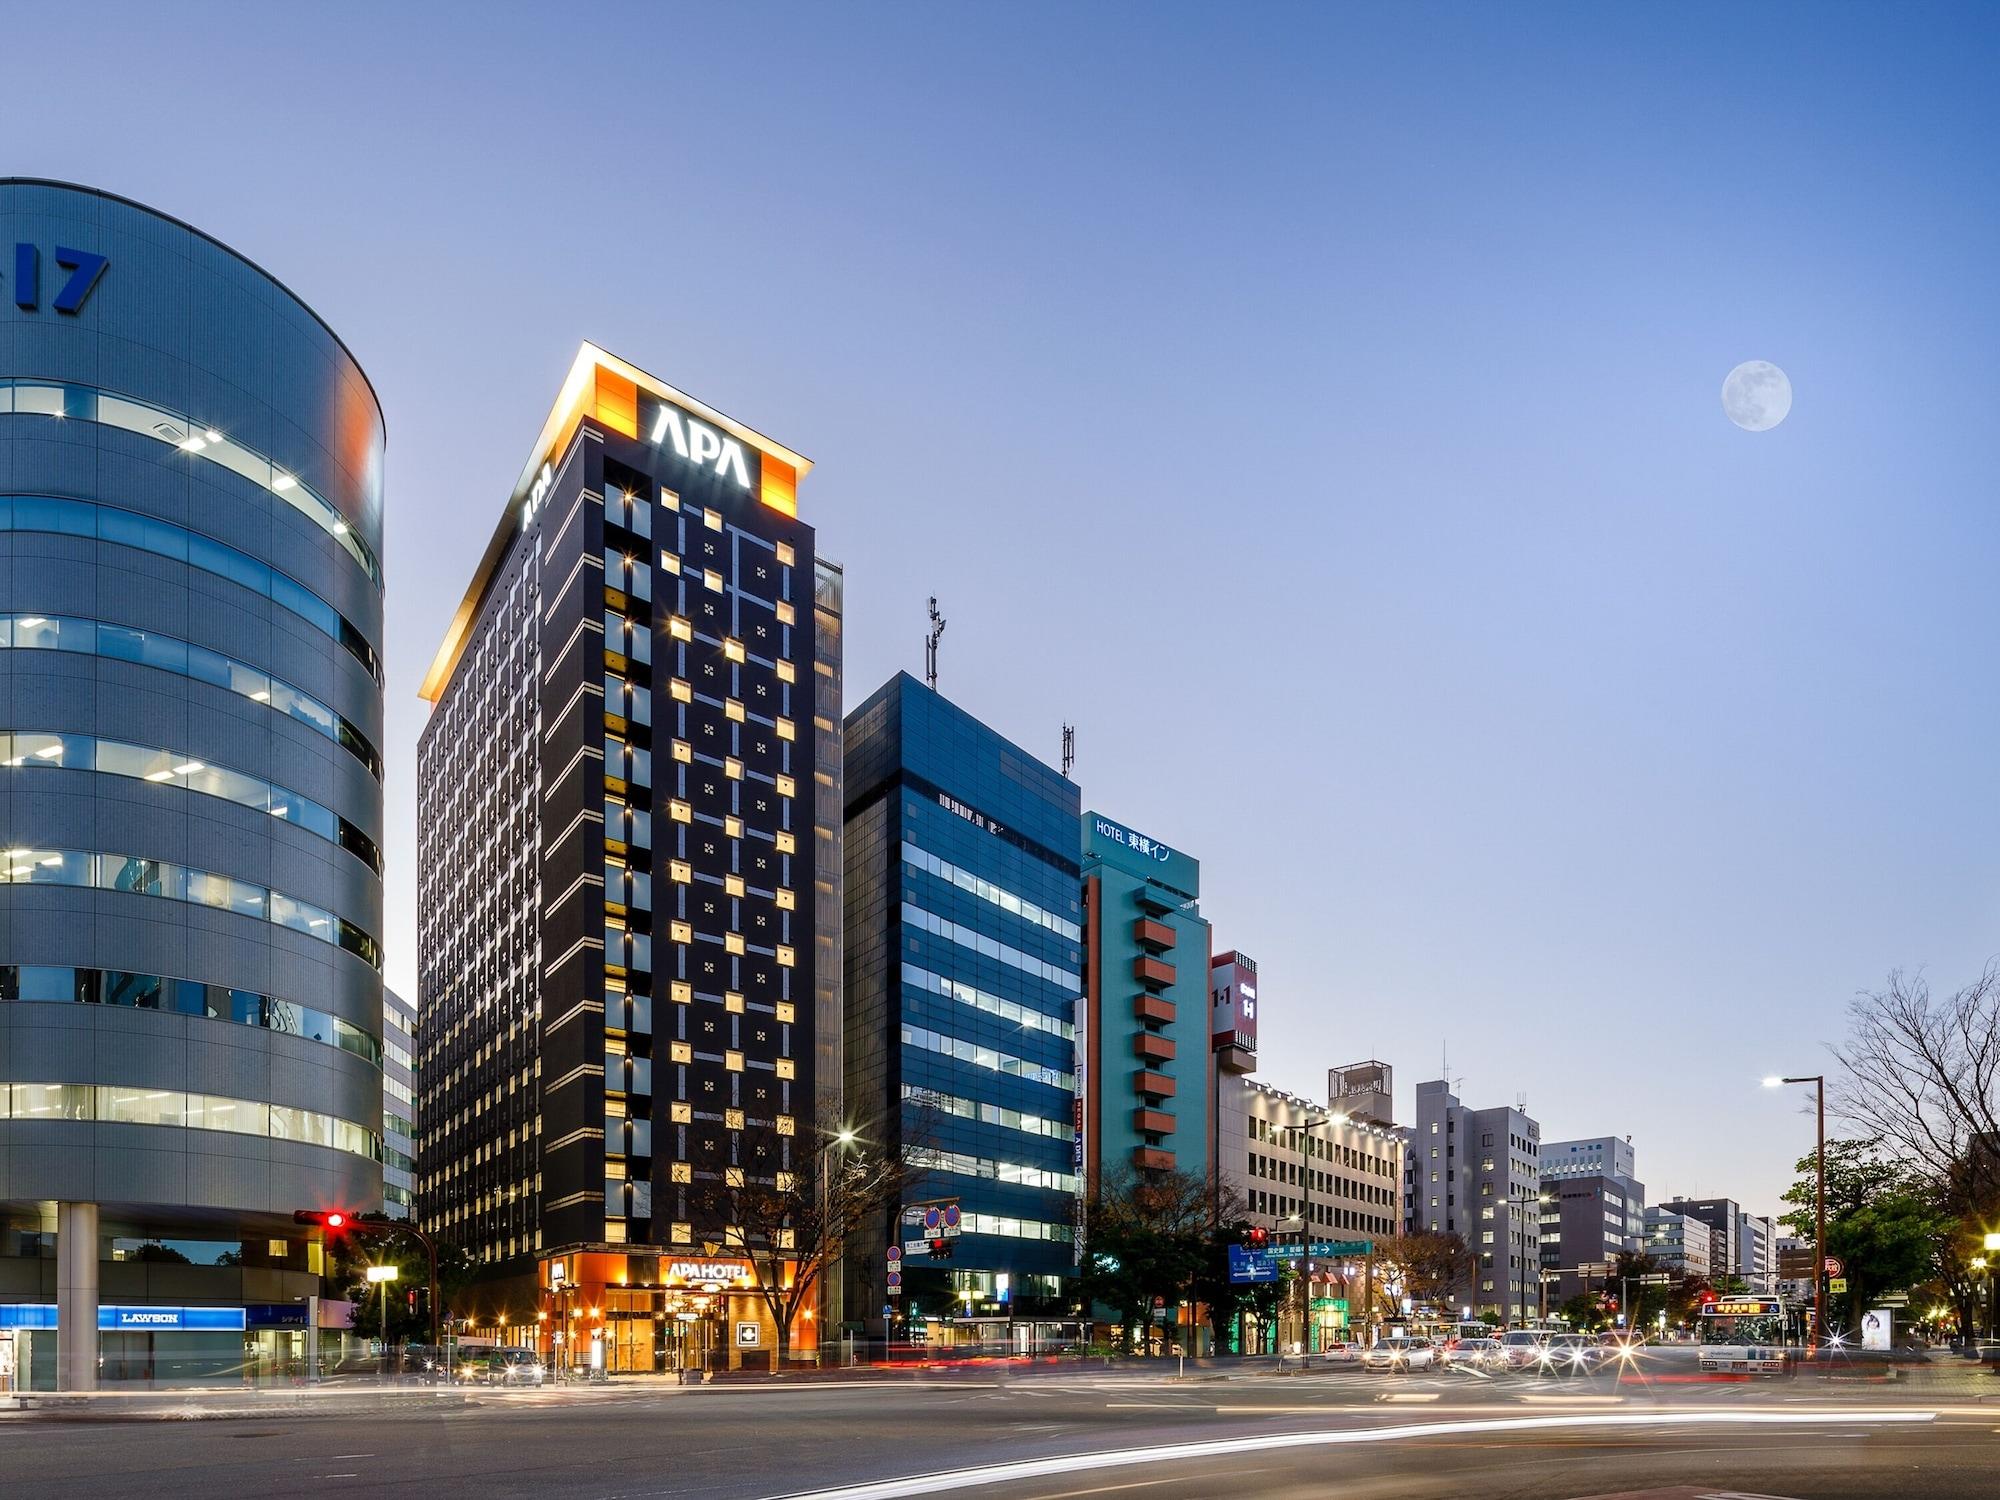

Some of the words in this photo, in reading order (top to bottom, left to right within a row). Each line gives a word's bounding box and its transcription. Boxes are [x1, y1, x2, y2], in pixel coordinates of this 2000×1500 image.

[651, 404, 751, 489] APA
[1096, 819, 1125, 844] HOTEL
[1128, 832, 1170, 862] 東横イン
[669, 1262, 700, 1278] APA
[701, 1264, 749, 1279] HOTEL
[121, 1313, 178, 1324] LAWSON
